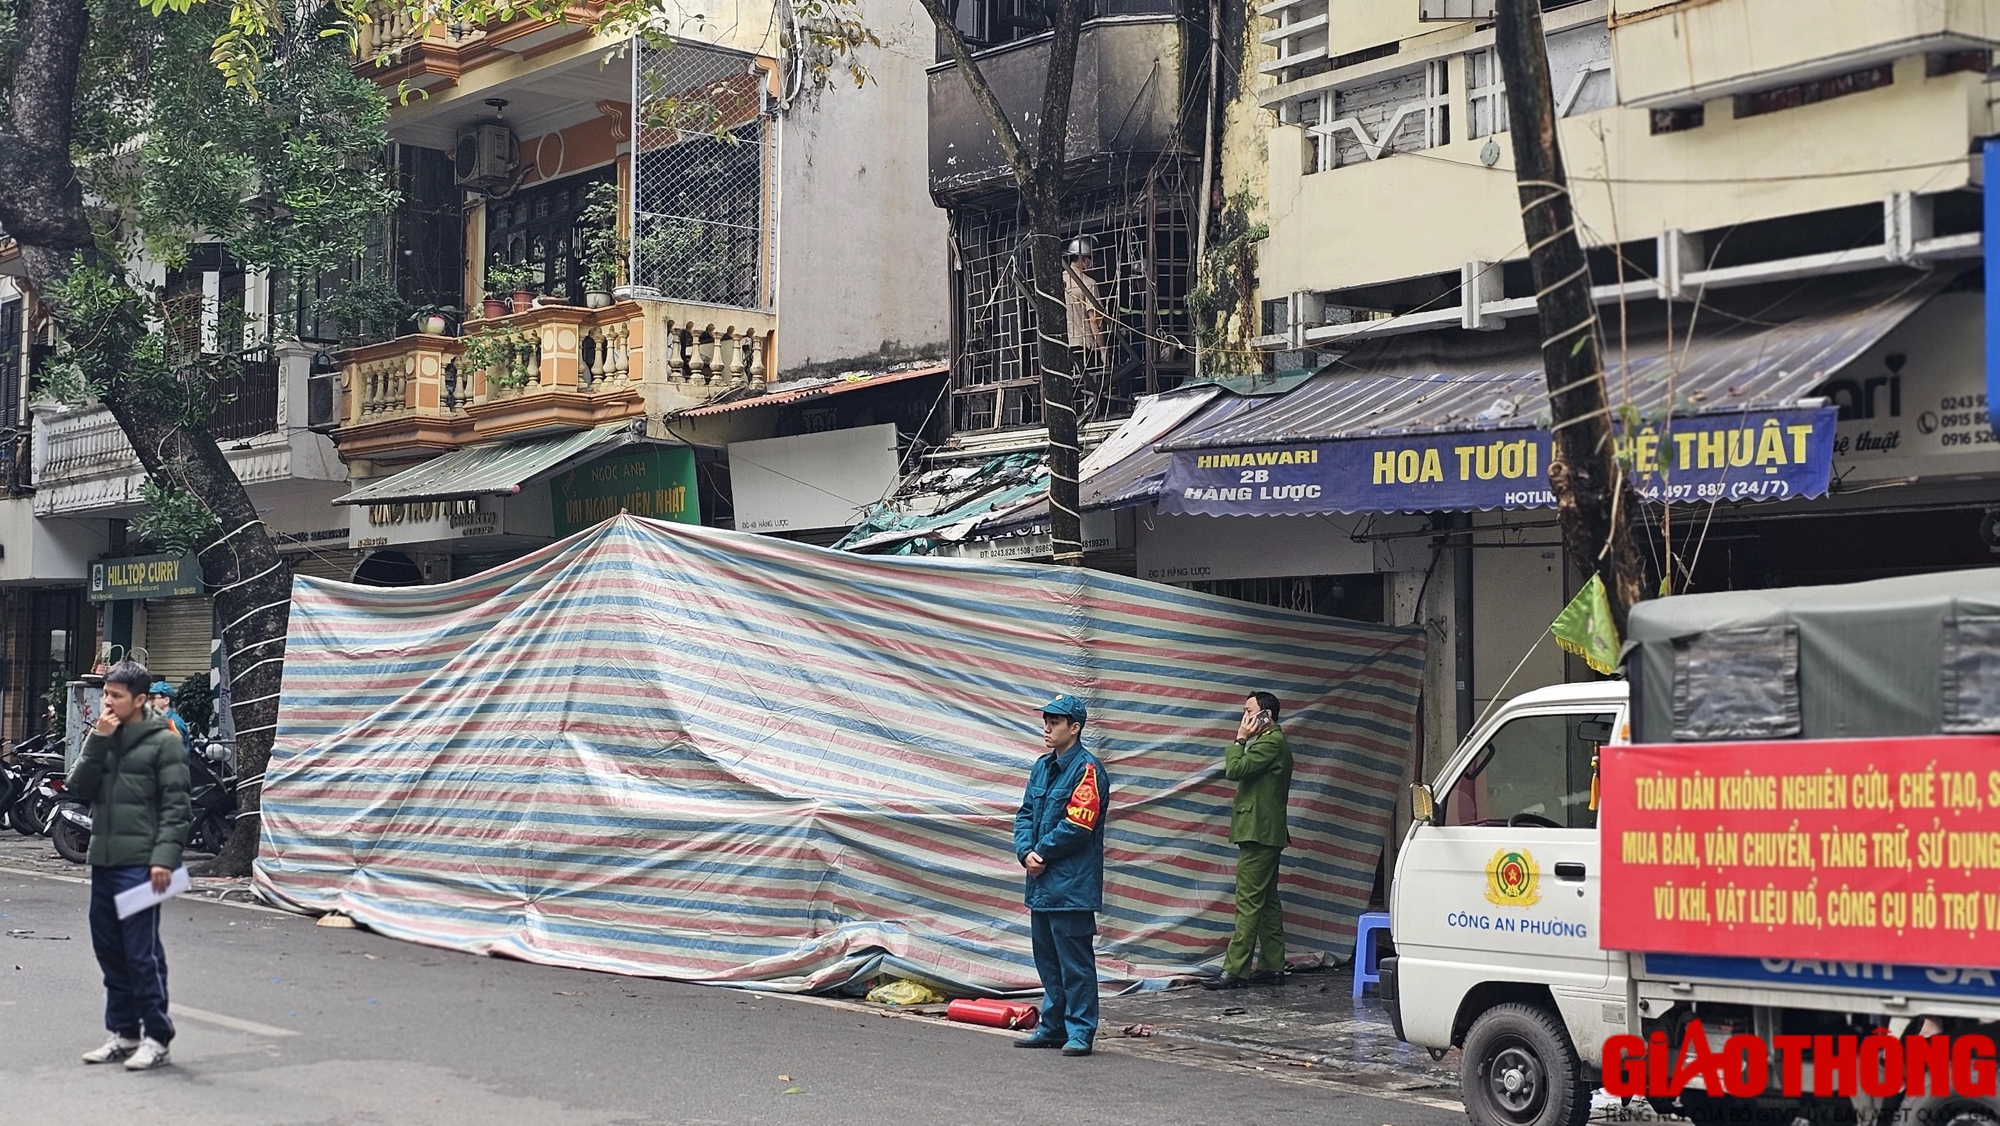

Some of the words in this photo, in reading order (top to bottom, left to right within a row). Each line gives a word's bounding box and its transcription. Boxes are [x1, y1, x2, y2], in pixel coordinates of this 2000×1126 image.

[1815, 353, 1907, 421] ari
[1941, 396, 1974, 411] 0243
[1941, 414, 1971, 428] 0915
[1855, 430, 1901, 454] thuật
[1941, 433, 1971, 447] 0916
[1197, 450, 1318, 469] HIMAWARI
[1372, 448, 1444, 485] HOA
[1454, 439, 1538, 481] TƯƠI
[1673, 418, 1813, 474] THUẬT
[623, 461, 646, 477] ANH
[1239, 469, 1269, 483] 2B
[1184, 485, 1253, 501] HÀNG
[1260, 484, 1321, 501] LƯỢC
[1505, 490, 1557, 505] HOTLIN
[1663, 484, 1692, 498] 497
[1697, 483, 1726, 497] 887
[1731, 480, 1789, 498] (24/7)
[655, 481, 686, 519] NHẬT
[108, 562, 146, 586] HILLTOP
[148, 560, 180, 583] CURRY
[1167, 566, 1188, 577] HÀNG
[1635, 769, 1677, 811] TOÀN
[1681, 769, 1715, 811] DÂN
[1719, 768, 1777, 811] KHÔNG
[1781, 767, 1847, 810] NGHIÊN
[1852, 763, 1895, 813] CỨU,
[1899, 758, 1937, 809] CHẾ
[1940, 770, 1983, 816] TẠO,
[1988, 769, 2000, 808] S
[1622, 831, 1658, 865] MUA
[1662, 825, 1700, 870] BÁN,
[1704, 824, 1738, 874] VẬN
[1743, 818, 1816, 873] CHUYỂN,
[1820, 824, 1868, 868] TÀNG
[1872, 822, 1912, 873] TRỮ,
[1917, 816, 1946, 869] SỬ
[1949, 831, 2000, 877] DỤNG
[1654, 880, 1675, 921] VŨ
[1679, 880, 1711, 927] KHÍ,
[1715, 880, 1747, 931] VẬT
[1750, 882, 1787, 932] LIỆU
[1792, 876, 1823, 931] NỔ,
[1827, 882, 1877, 928] CÔNG
[1881, 890, 1907, 937] CỤ
[1911, 878, 1938, 930] HỖ
[1941, 889, 1981, 940] TRỢ
[1447, 911, 1490, 930] CÔNG
[1494, 917, 1515, 933] AN
[1520, 916, 1588, 938] PHƯỜNG
